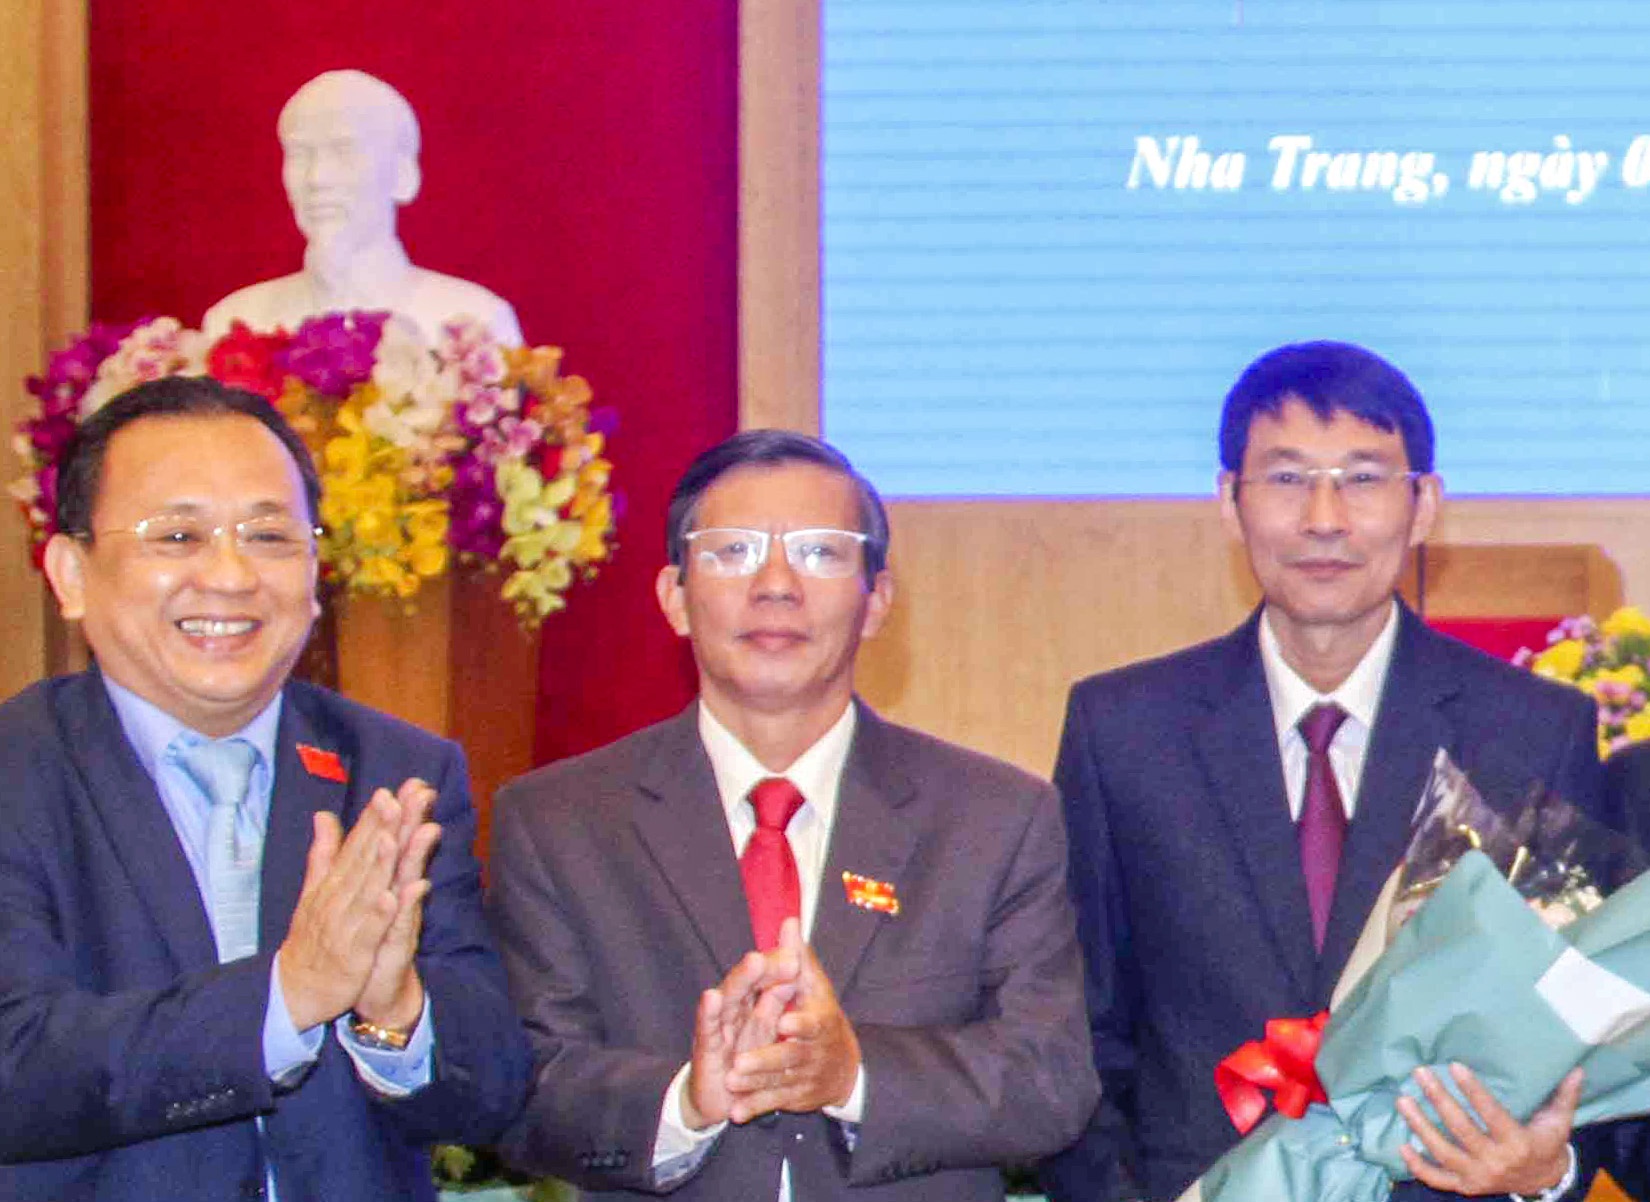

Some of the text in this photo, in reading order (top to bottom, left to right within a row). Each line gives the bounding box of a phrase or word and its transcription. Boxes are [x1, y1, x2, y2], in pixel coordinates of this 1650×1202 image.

[1127, 135, 1246, 189] Nha
[1267, 134, 1450, 204] Trang,
[1468, 134, 1610, 205] ngày
